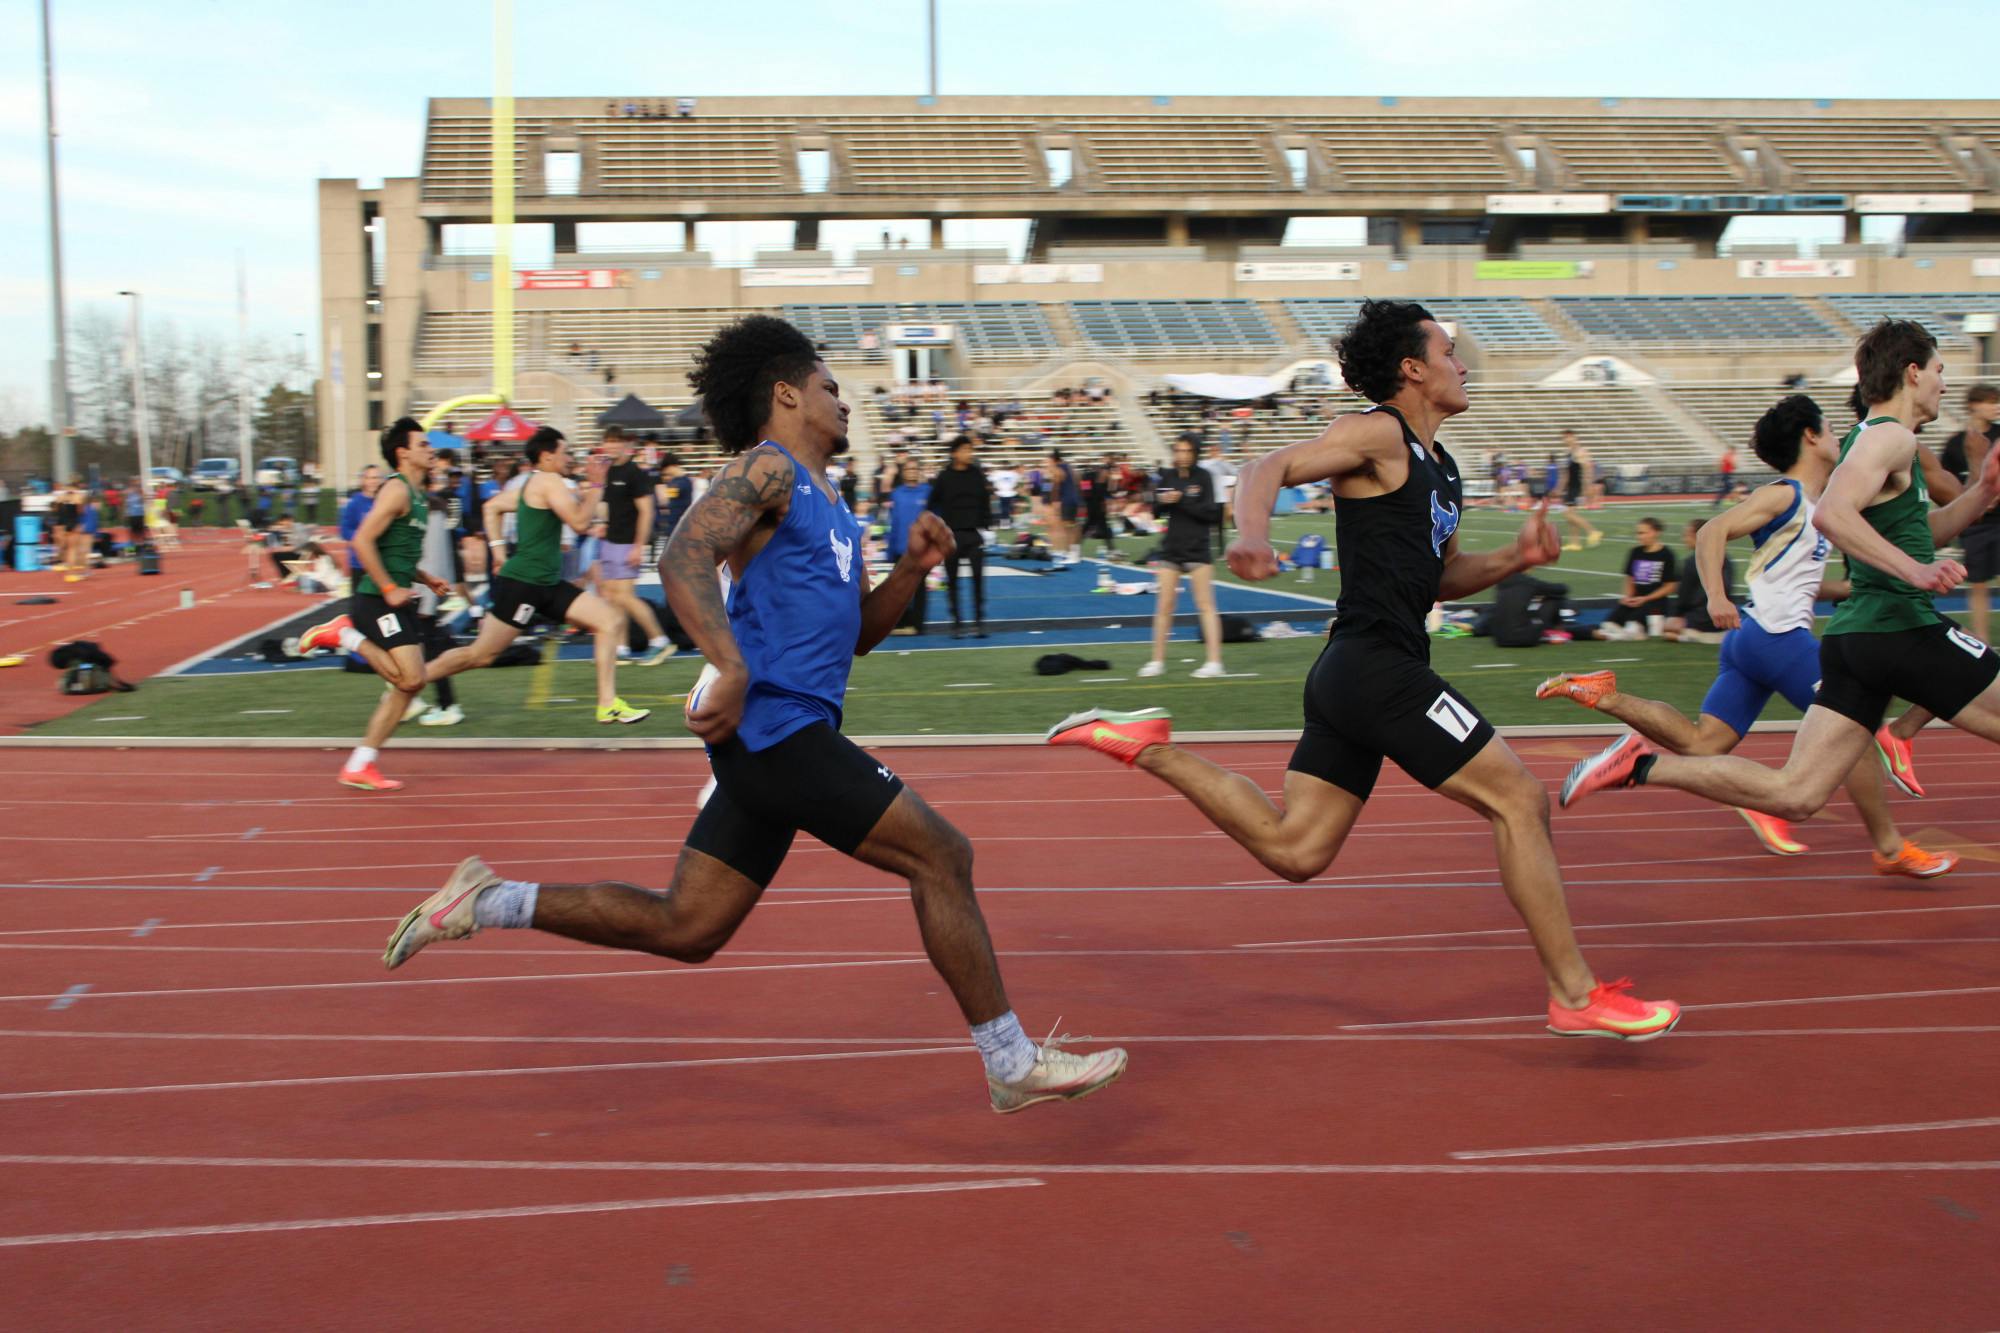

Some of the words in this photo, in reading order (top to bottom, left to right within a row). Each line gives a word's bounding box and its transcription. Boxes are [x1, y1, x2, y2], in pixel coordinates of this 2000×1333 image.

[382, 617, 396, 633] 2
[1953, 630, 1984, 650] 6
[1434, 698, 1470, 734] 7
